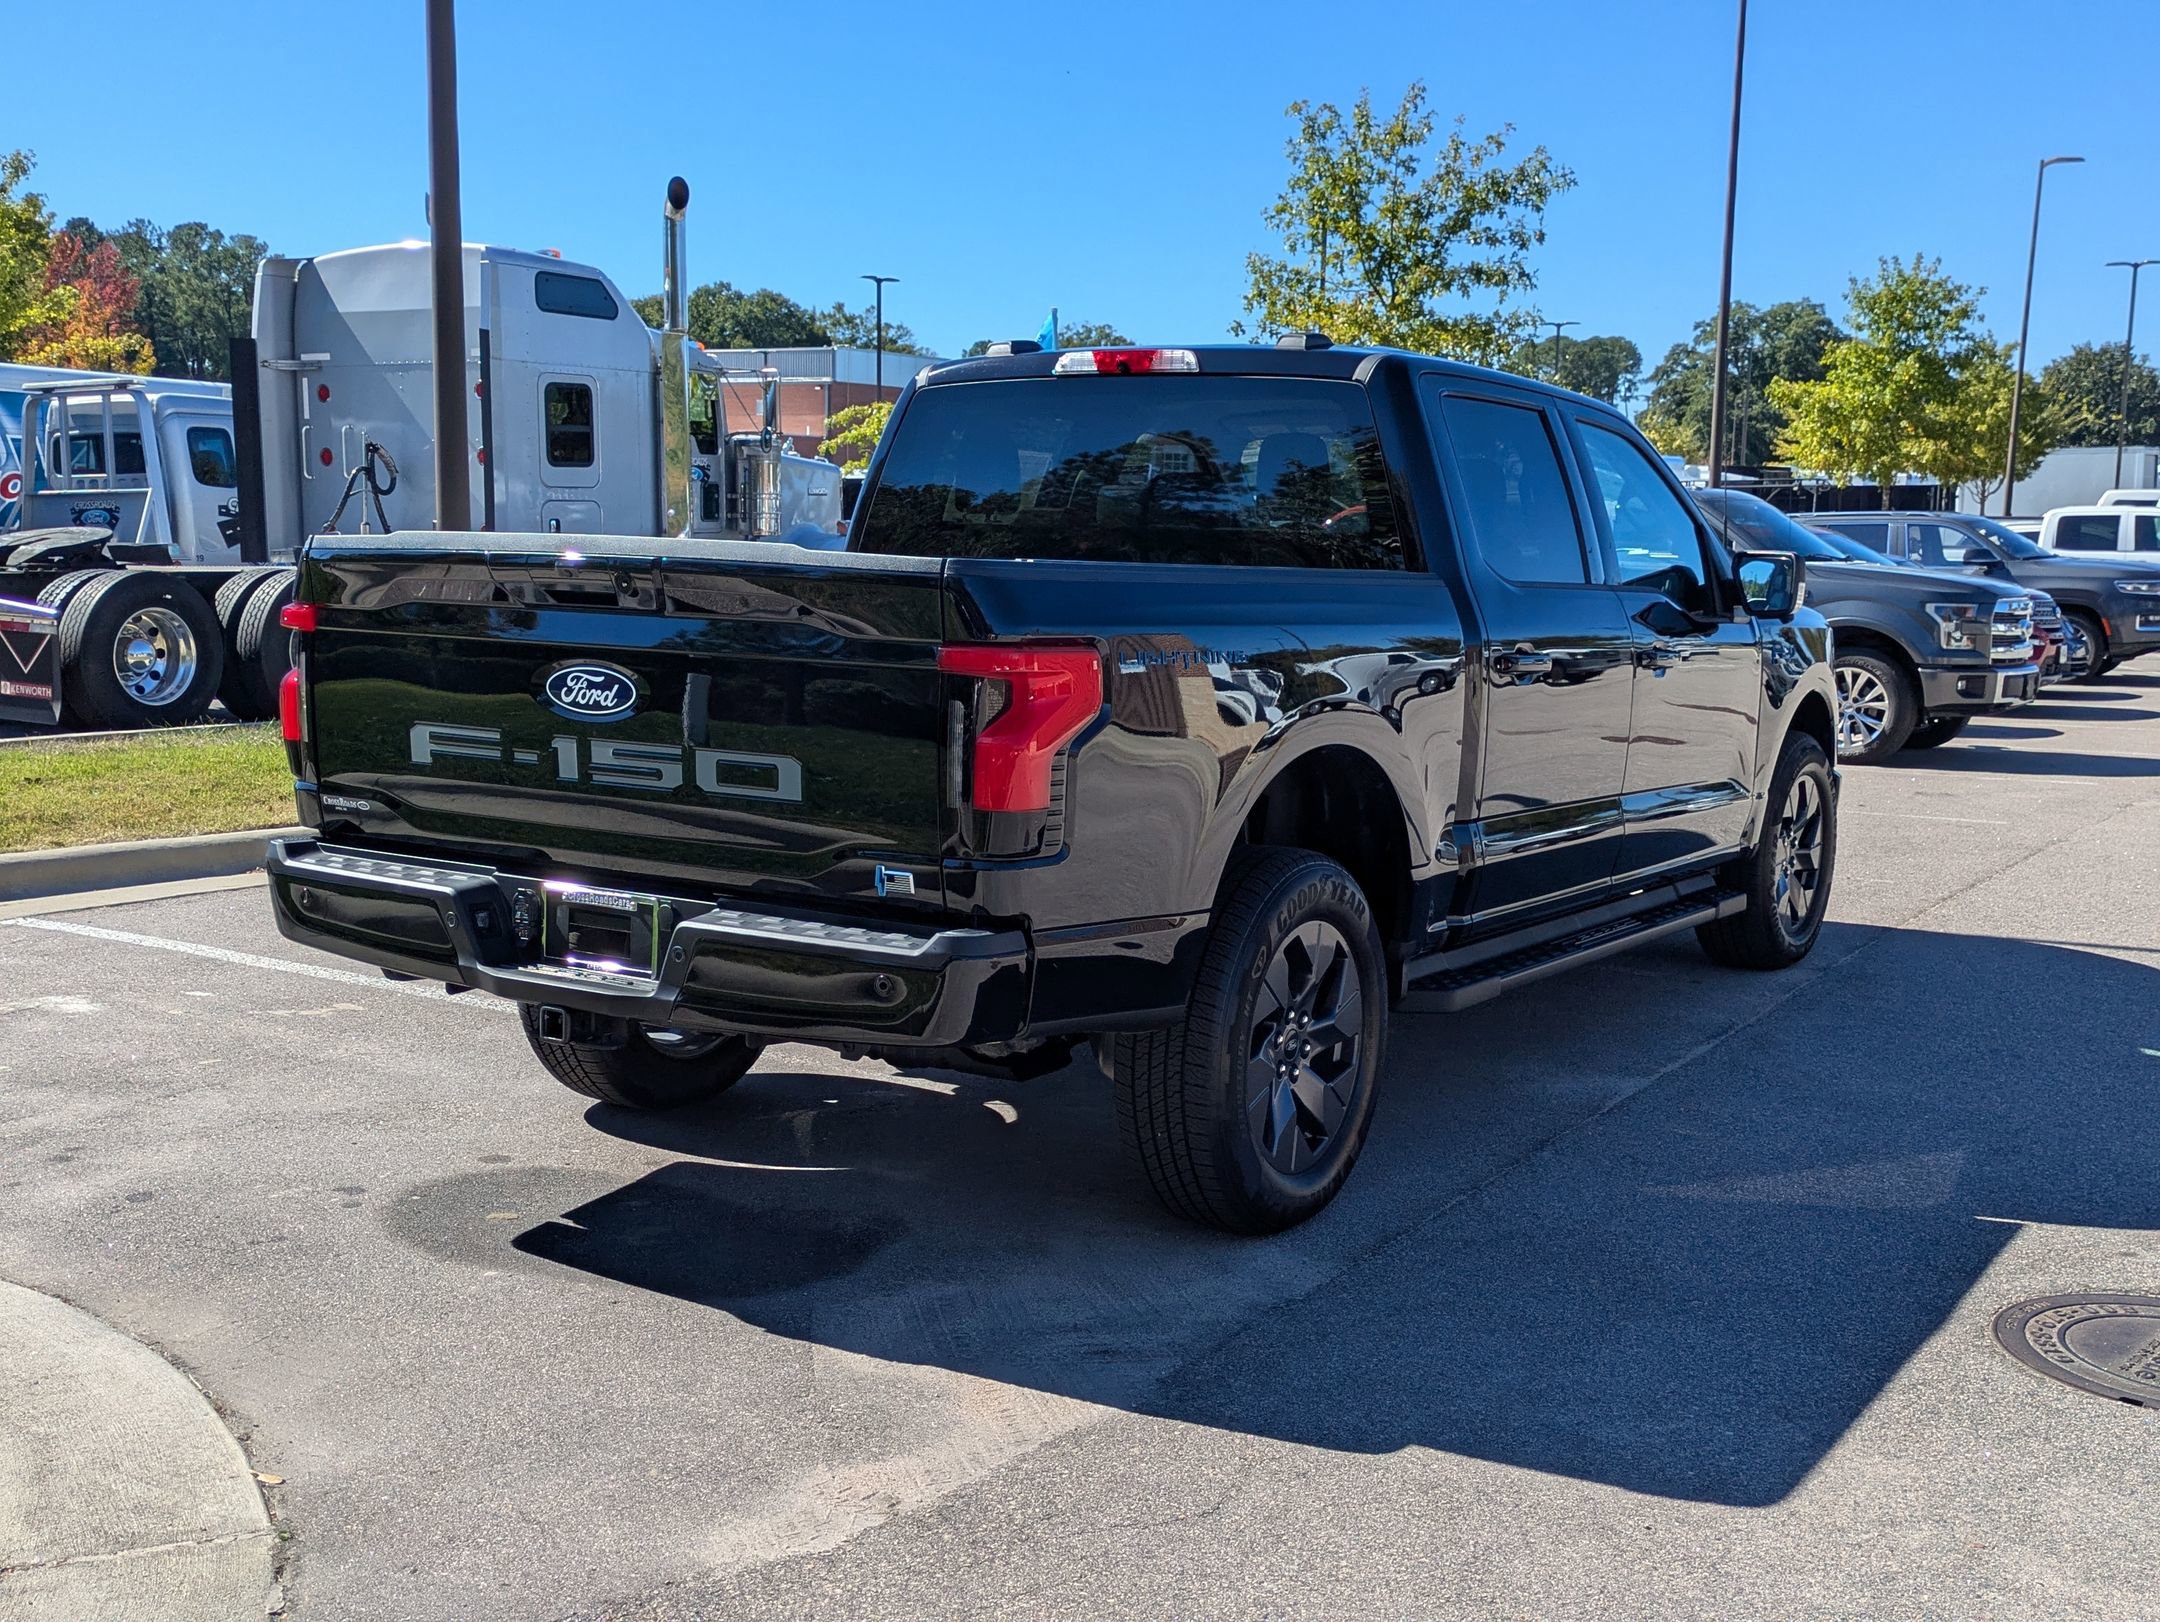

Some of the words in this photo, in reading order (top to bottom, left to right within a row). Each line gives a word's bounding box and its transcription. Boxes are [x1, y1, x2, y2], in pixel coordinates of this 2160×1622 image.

[1119, 649, 1249, 669] LIGHTNING
[11, 683, 52, 698] KENWORTH
[561, 672, 618, 708] Ford
[409, 720, 802, 801] F-150
[1276, 878, 1366, 933] GOODYEAR
